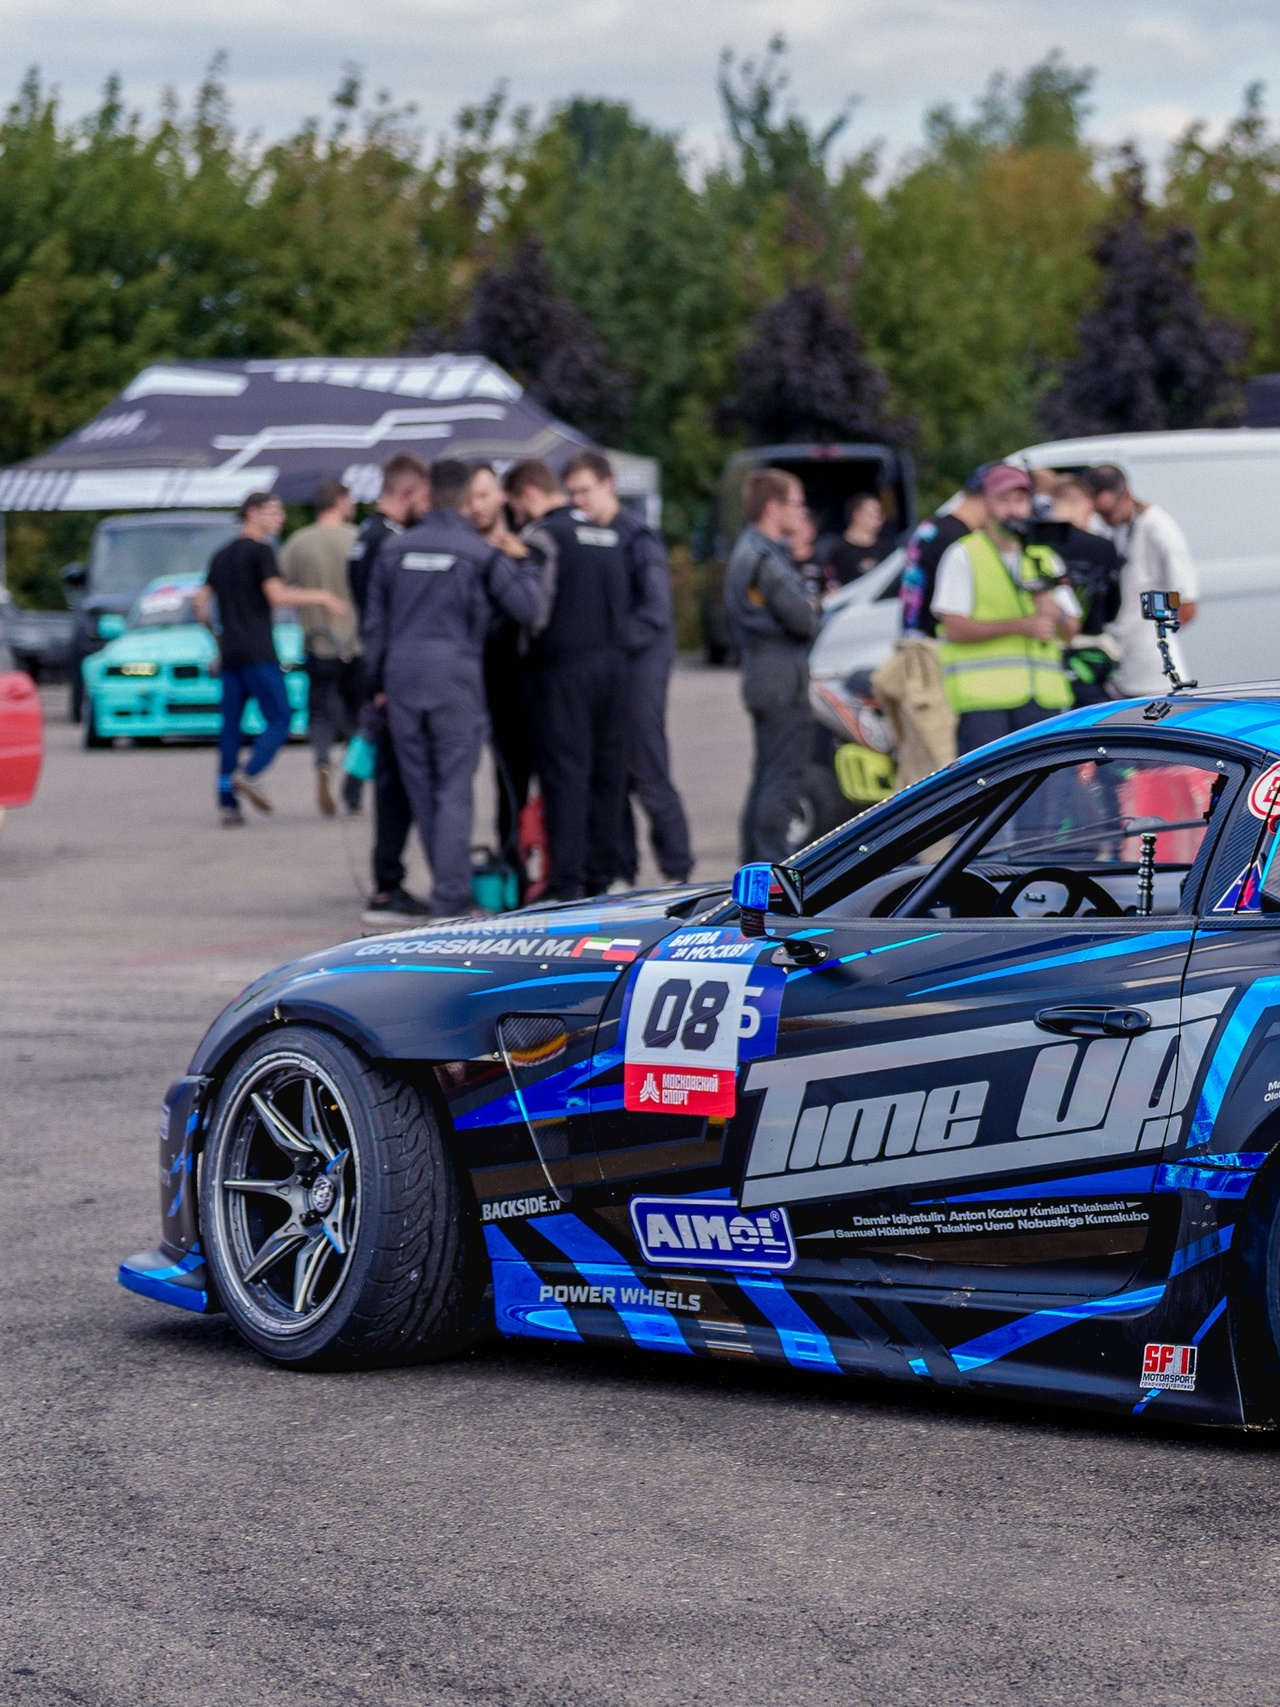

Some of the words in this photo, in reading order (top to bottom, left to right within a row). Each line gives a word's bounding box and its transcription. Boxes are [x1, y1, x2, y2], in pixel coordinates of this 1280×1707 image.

[354, 938, 538, 958] GROSSMAN
[538, 939, 571, 958] M.
[668, 930, 721, 947] БИТВА
[671, 948, 689, 958] ЗА
[684, 943, 755, 960] МОСКВУ
[641, 978, 730, 1052] 08
[662, 1073, 718, 1092] МОСКОВСКИЙ
[662, 1089, 689, 1105] СПОРТ
[482, 1195, 560, 1220] BACKSIDE.TV
[853, 1215, 890, 1226] Damir
[892, 1212, 946, 1225] Idiyatulin
[949, 1210, 986, 1221] Anton
[987, 1208, 1028, 1219] Kozlov
[1030, 1204, 1070, 1217] Kuniaki
[1071, 1201, 1125, 1214] Takahashi
[835, 1227, 876, 1238] Samuel
[878, 1224, 931, 1236] Hübinette
[934, 1221, 983, 1233] Takahiro
[984, 1221, 1014, 1232] Ueno
[1017, 1215, 1083, 1230] Nobushige
[1085, 1212, 1149, 1225] Kumakubo
[539, 1285, 616, 1303] POWER
[620, 1287, 701, 1311] WHEELS
[1142, 1373, 1195, 1385] MOTORSPORT
